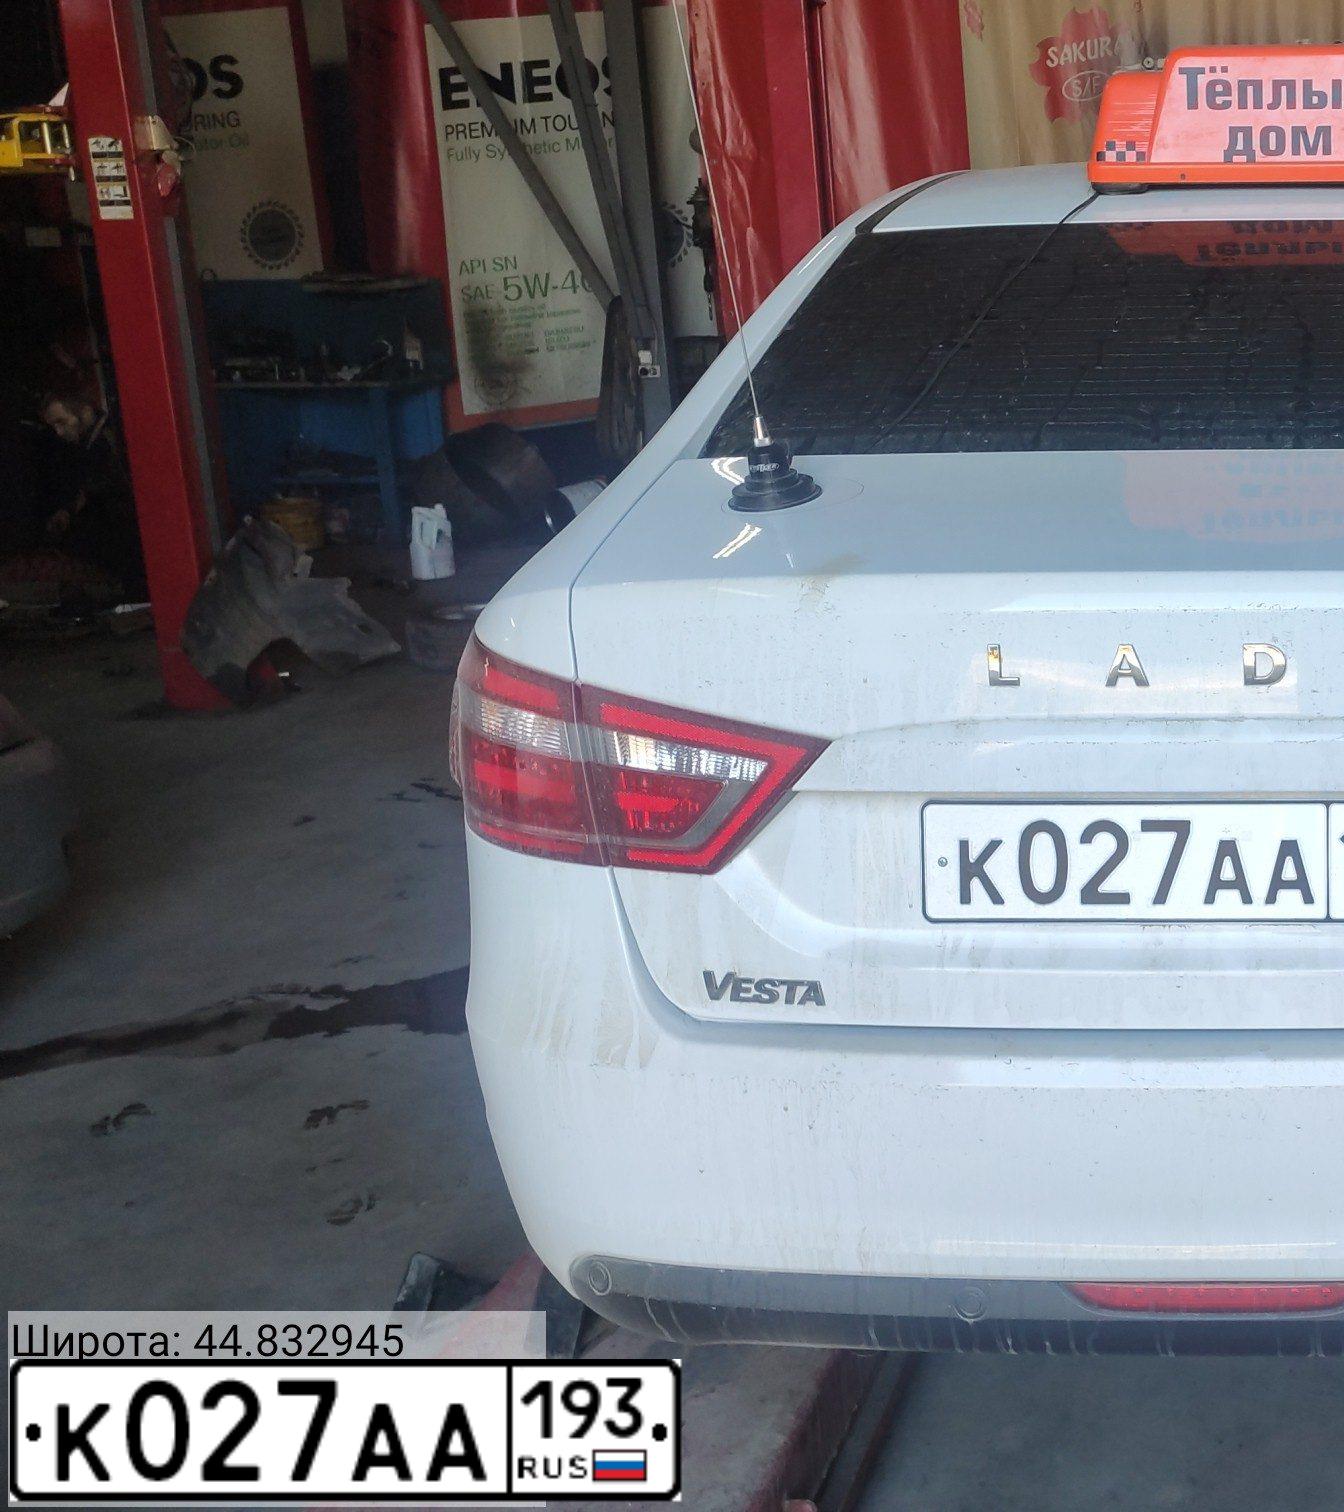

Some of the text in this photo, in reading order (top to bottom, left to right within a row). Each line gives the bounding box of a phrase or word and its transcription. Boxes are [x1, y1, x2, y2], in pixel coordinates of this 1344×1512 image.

[444, 118, 537, 142] PREMM
[447, 145, 481, 163] Fully
[1223, 125, 1332, 162] дом
[459, 256, 518, 276] API SN
[461, 284, 495, 302] SAE
[702, 970, 827, 1007] VESTA
